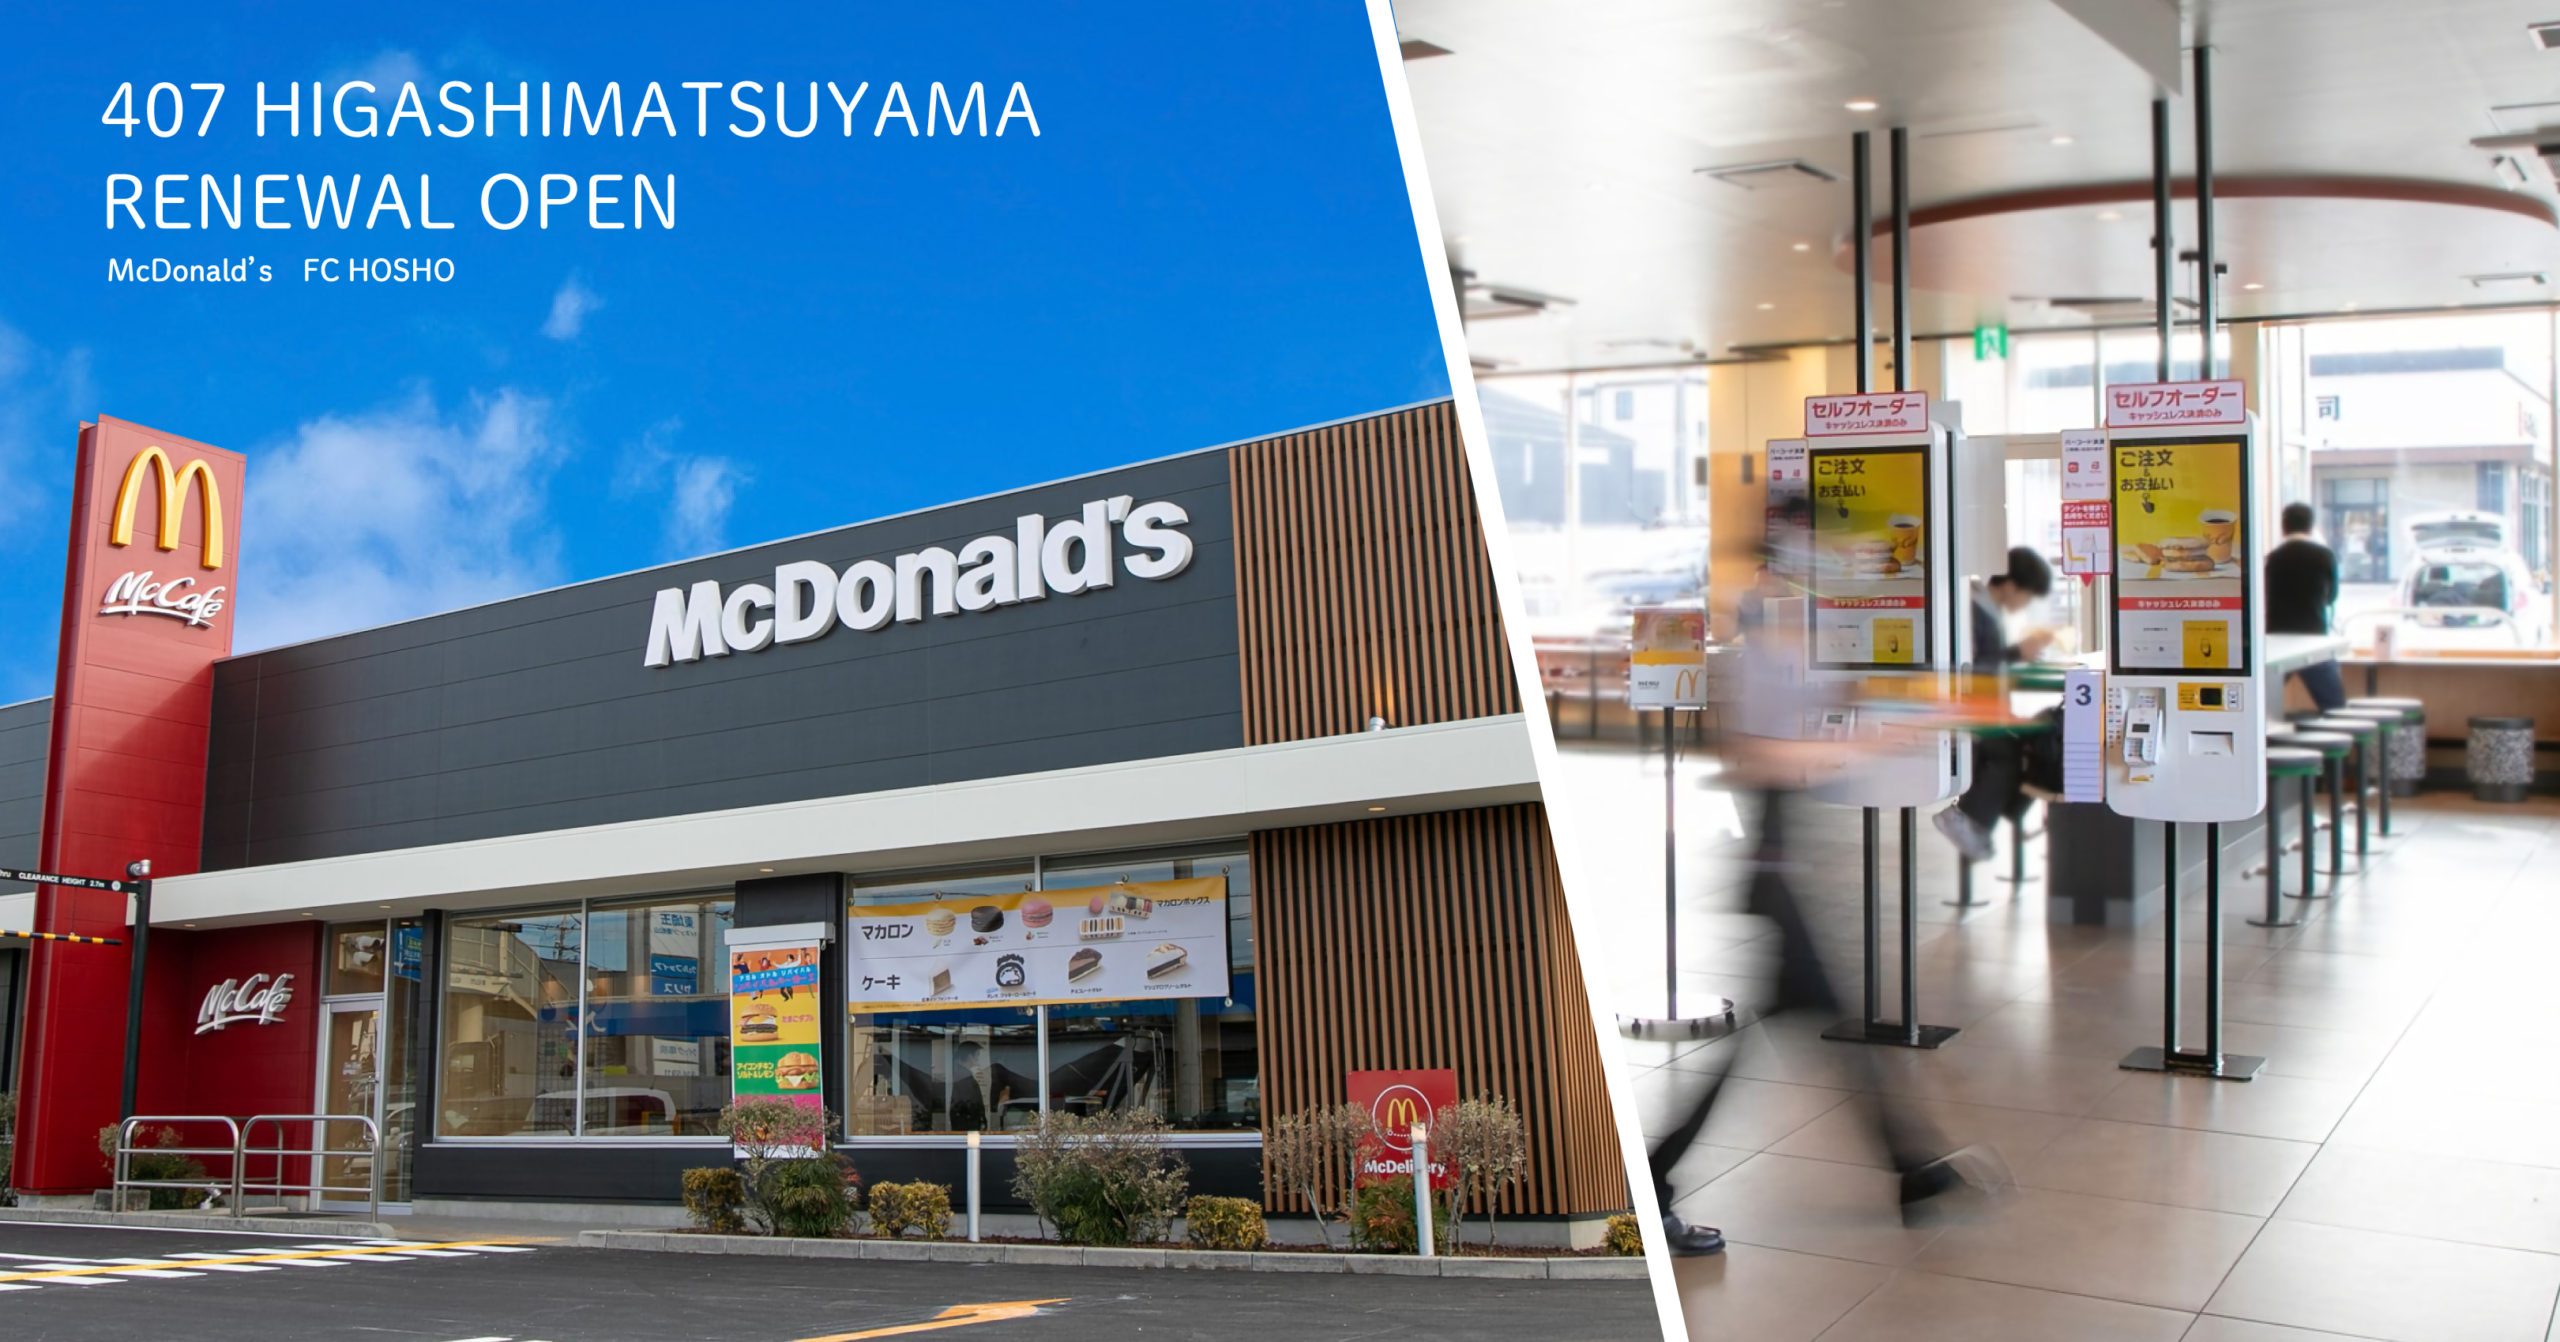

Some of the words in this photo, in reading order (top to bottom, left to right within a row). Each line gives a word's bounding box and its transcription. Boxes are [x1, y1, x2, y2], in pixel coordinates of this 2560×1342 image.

[2114, 386, 2238, 409] セルフオーダー
[1812, 397, 1921, 419] セルフオーダー
[1818, 458, 1866, 476] ご注文
[2120, 449, 2174, 467] ご注文
[1818, 484, 1866, 498] お支払い
[2121, 477, 2174, 491] お支払い
[643, 494, 1195, 668] McDonald's
[2075, 683, 2092, 706] 3
[18, 872, 60, 884] CLEARANCE
[61, 877, 86, 887] HEIGHT
[861, 924, 914, 940] マカロン
[861, 974, 901, 991] ケーキ
